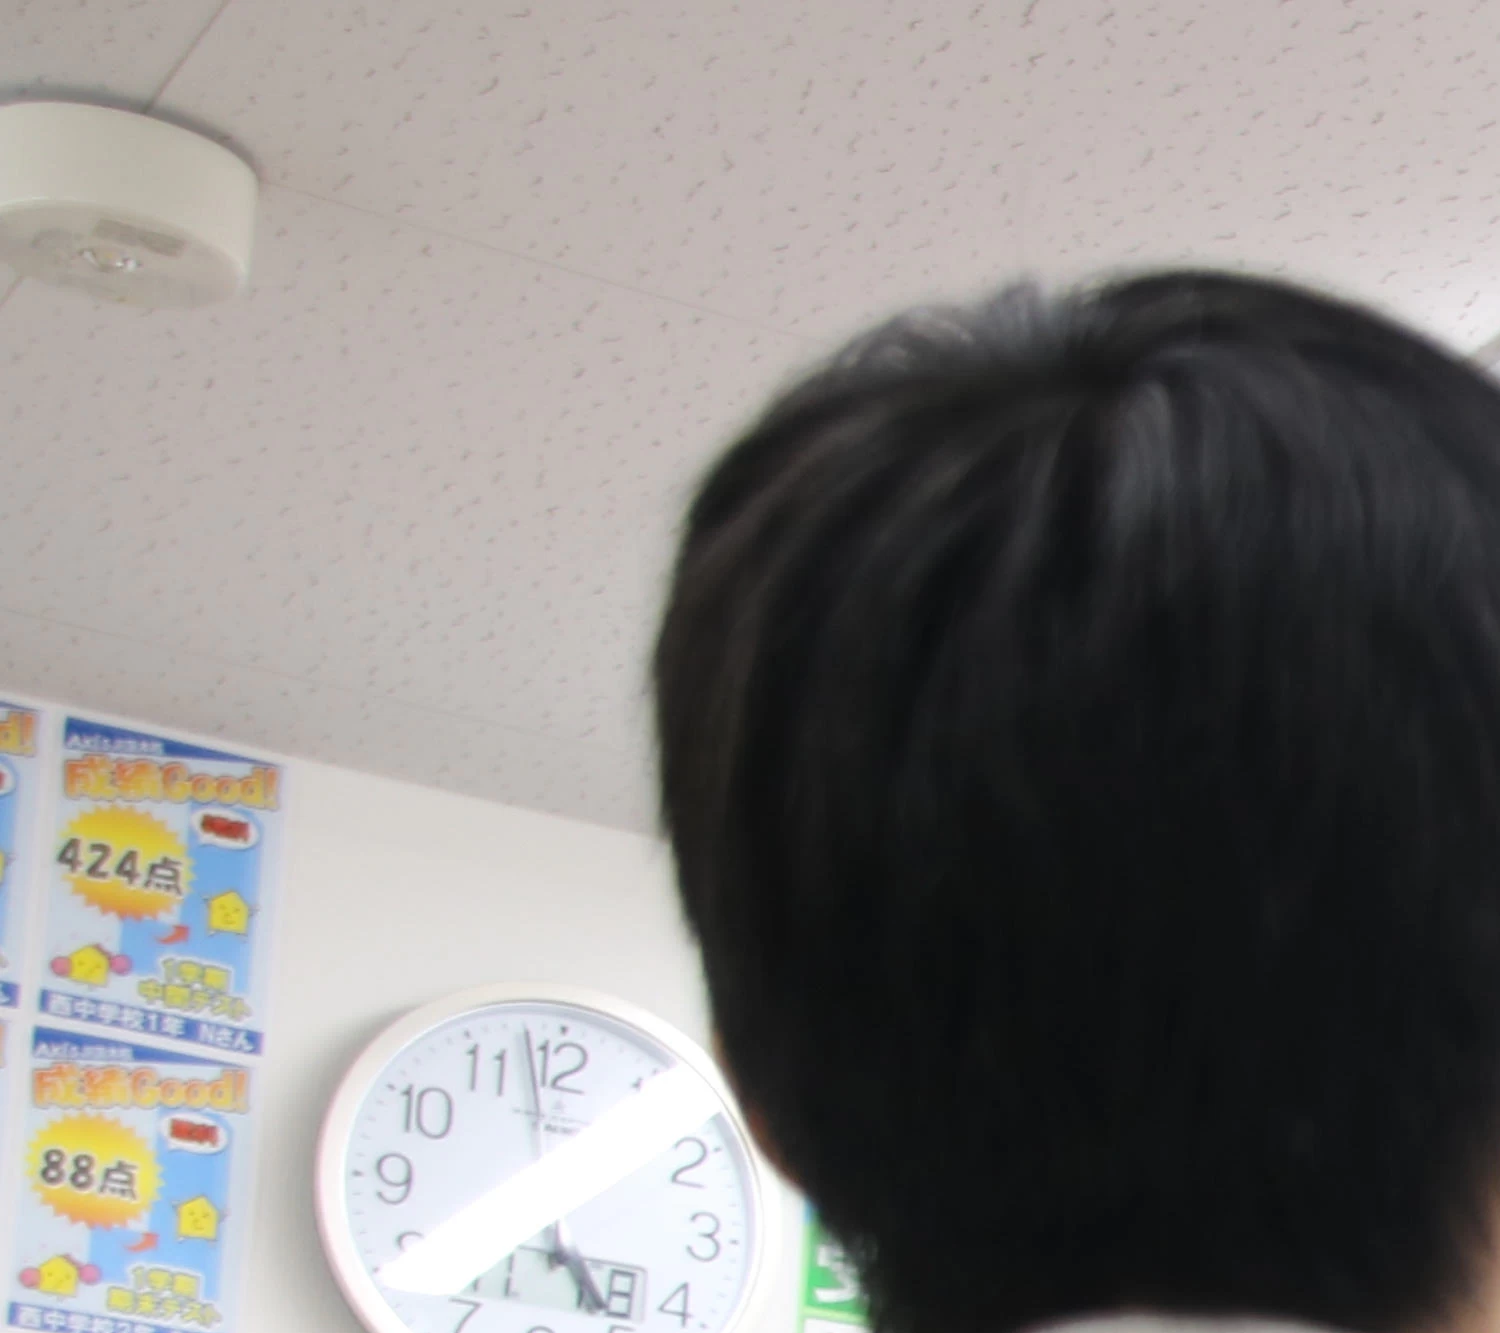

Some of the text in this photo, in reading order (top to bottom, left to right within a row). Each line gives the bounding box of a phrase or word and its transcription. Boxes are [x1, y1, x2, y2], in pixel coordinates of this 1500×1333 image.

[56, 837, 183, 896] 424点
[465, 1043, 506, 1097] 11
[538, 1039, 588, 1095] 12
[401, 1084, 453, 1140] 10
[40, 1148, 137, 1200] 88点
[375, 1153, 413, 1205] 9
[671, 1137, 708, 1188] 2
[686, 1211, 721, 1262] 3
[658, 1282, 693, 1328] 4
